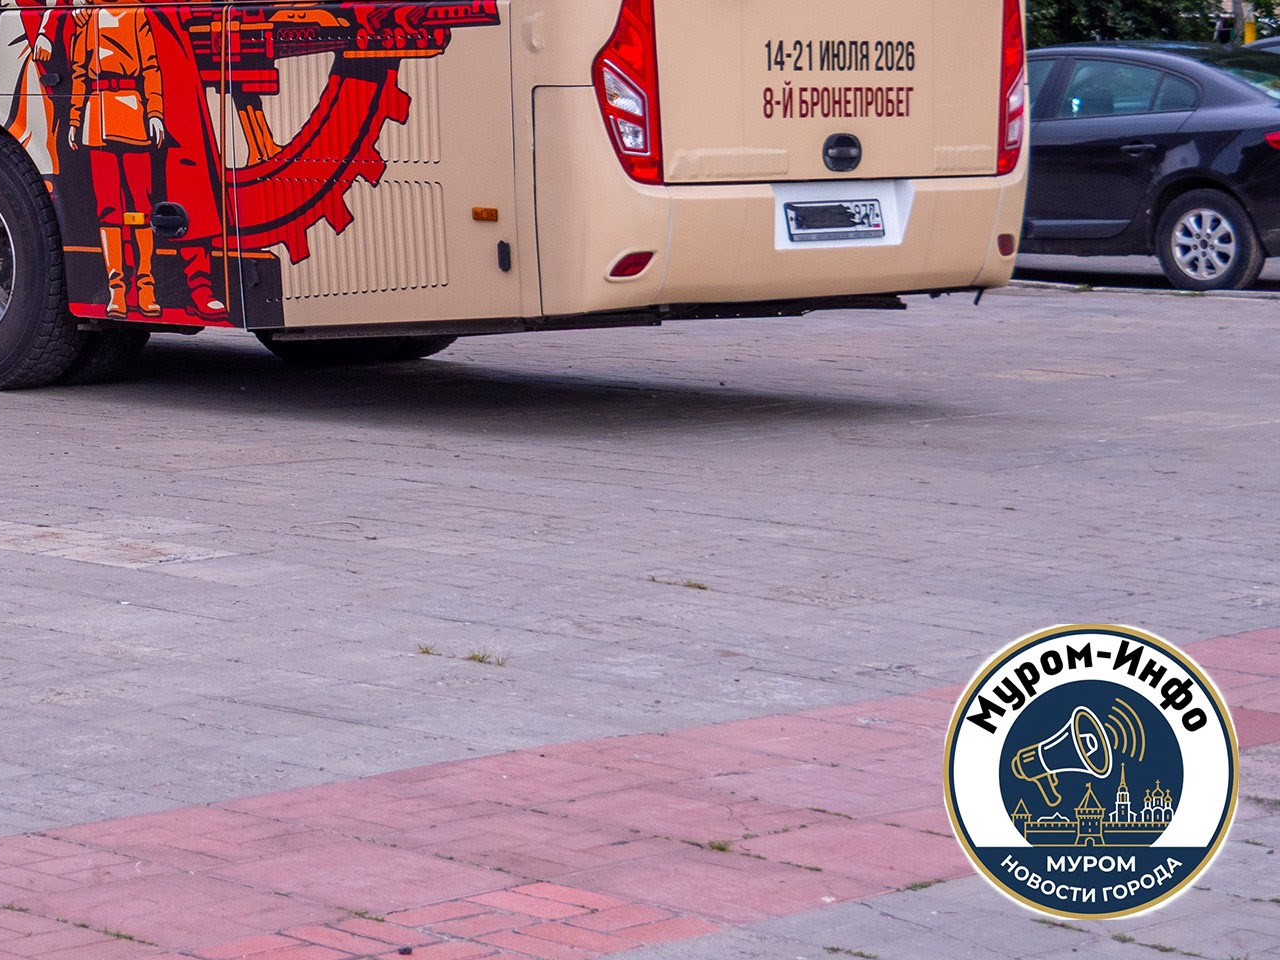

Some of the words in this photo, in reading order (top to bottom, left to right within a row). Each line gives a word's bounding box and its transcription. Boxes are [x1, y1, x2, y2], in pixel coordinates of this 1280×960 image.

[764, 40, 813, 71] 14-21
[819, 40, 870, 71] ИЮЛЯ
[875, 40, 915, 71] 2026
[763, 80, 793, 119] 8-Й
[798, 86, 914, 118] БРОНЕПРОБЕГ
